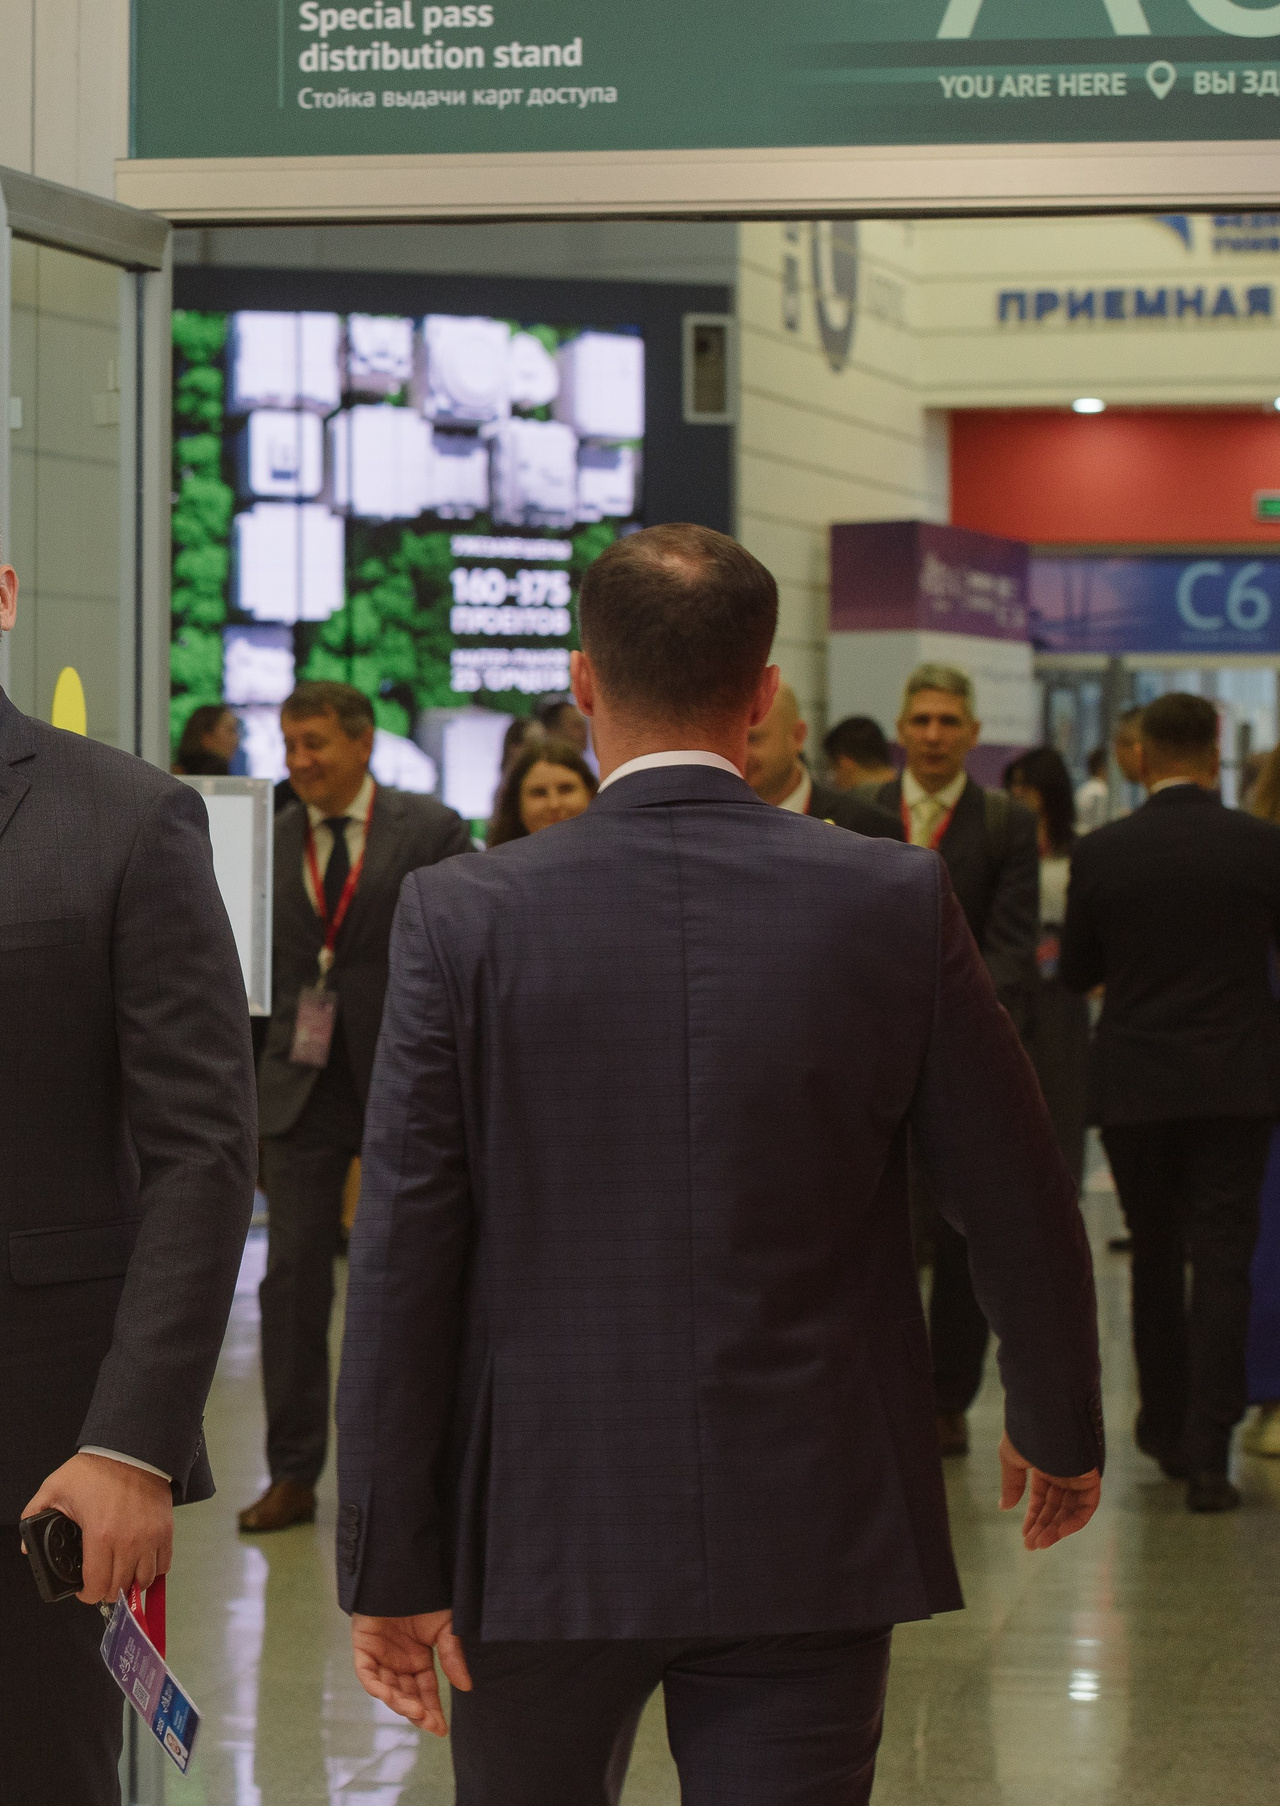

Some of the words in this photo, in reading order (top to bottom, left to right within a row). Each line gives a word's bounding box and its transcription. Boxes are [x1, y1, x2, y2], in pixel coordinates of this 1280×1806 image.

[299, 1, 414, 37] Special
[422, 4, 494, 35] pass
[298, 40, 485, 73] distribution
[493, 37, 583, 69] stand
[297, 87, 376, 110] Стойка
[382, 89, 467, 110] выдачи
[472, 87, 524, 110] карт
[526, 86, 618, 109] доступа
[938, 74, 994, 99] YOU
[999, 73, 1051, 97] ARE
[1058, 71, 1127, 96] HERE
[1193, 70, 1236, 95] ВЫ
[998, 284, 1272, 322] ПРИЕМНАЯ
[1177, 560, 1272, 631] C6
